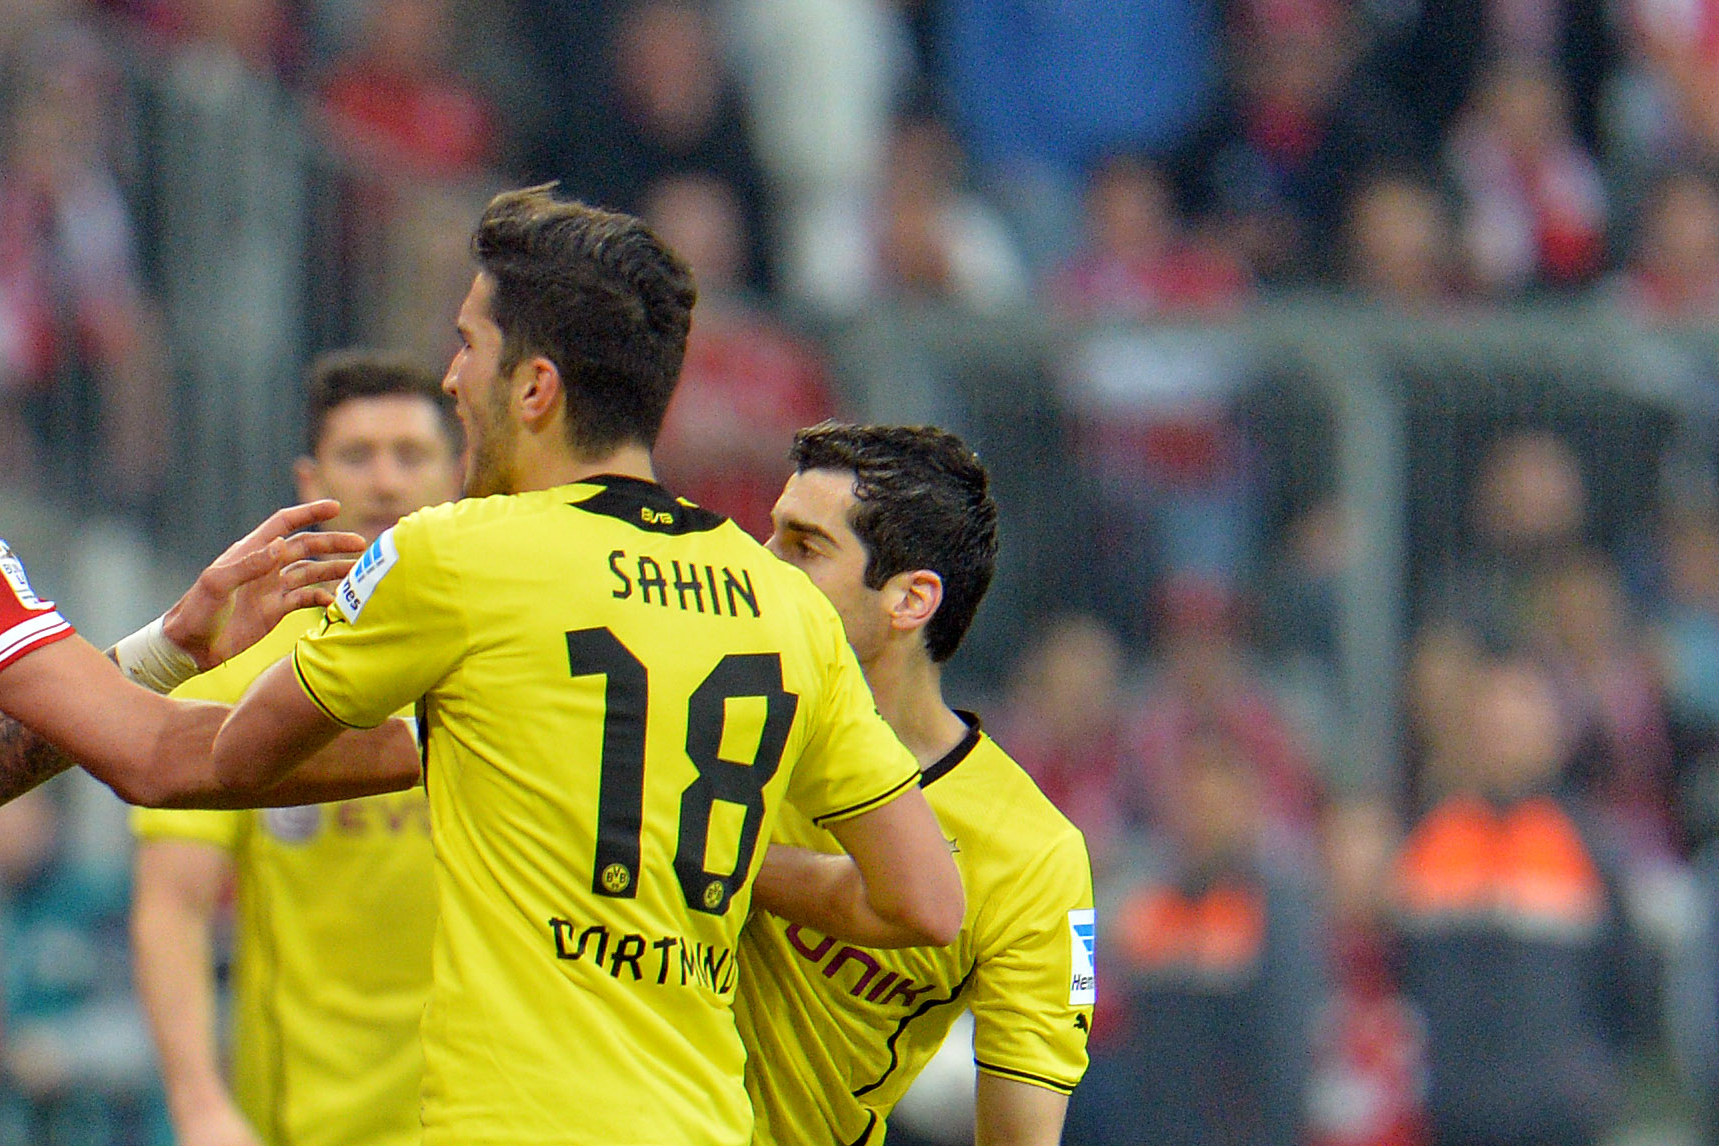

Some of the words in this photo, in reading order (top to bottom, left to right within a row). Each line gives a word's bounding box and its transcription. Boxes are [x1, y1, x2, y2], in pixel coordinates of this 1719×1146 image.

[640, 507, 674, 525] BVB
[341, 581, 361, 611] nes
[608, 549, 761, 618] SAHIN
[565, 626, 799, 916] 18
